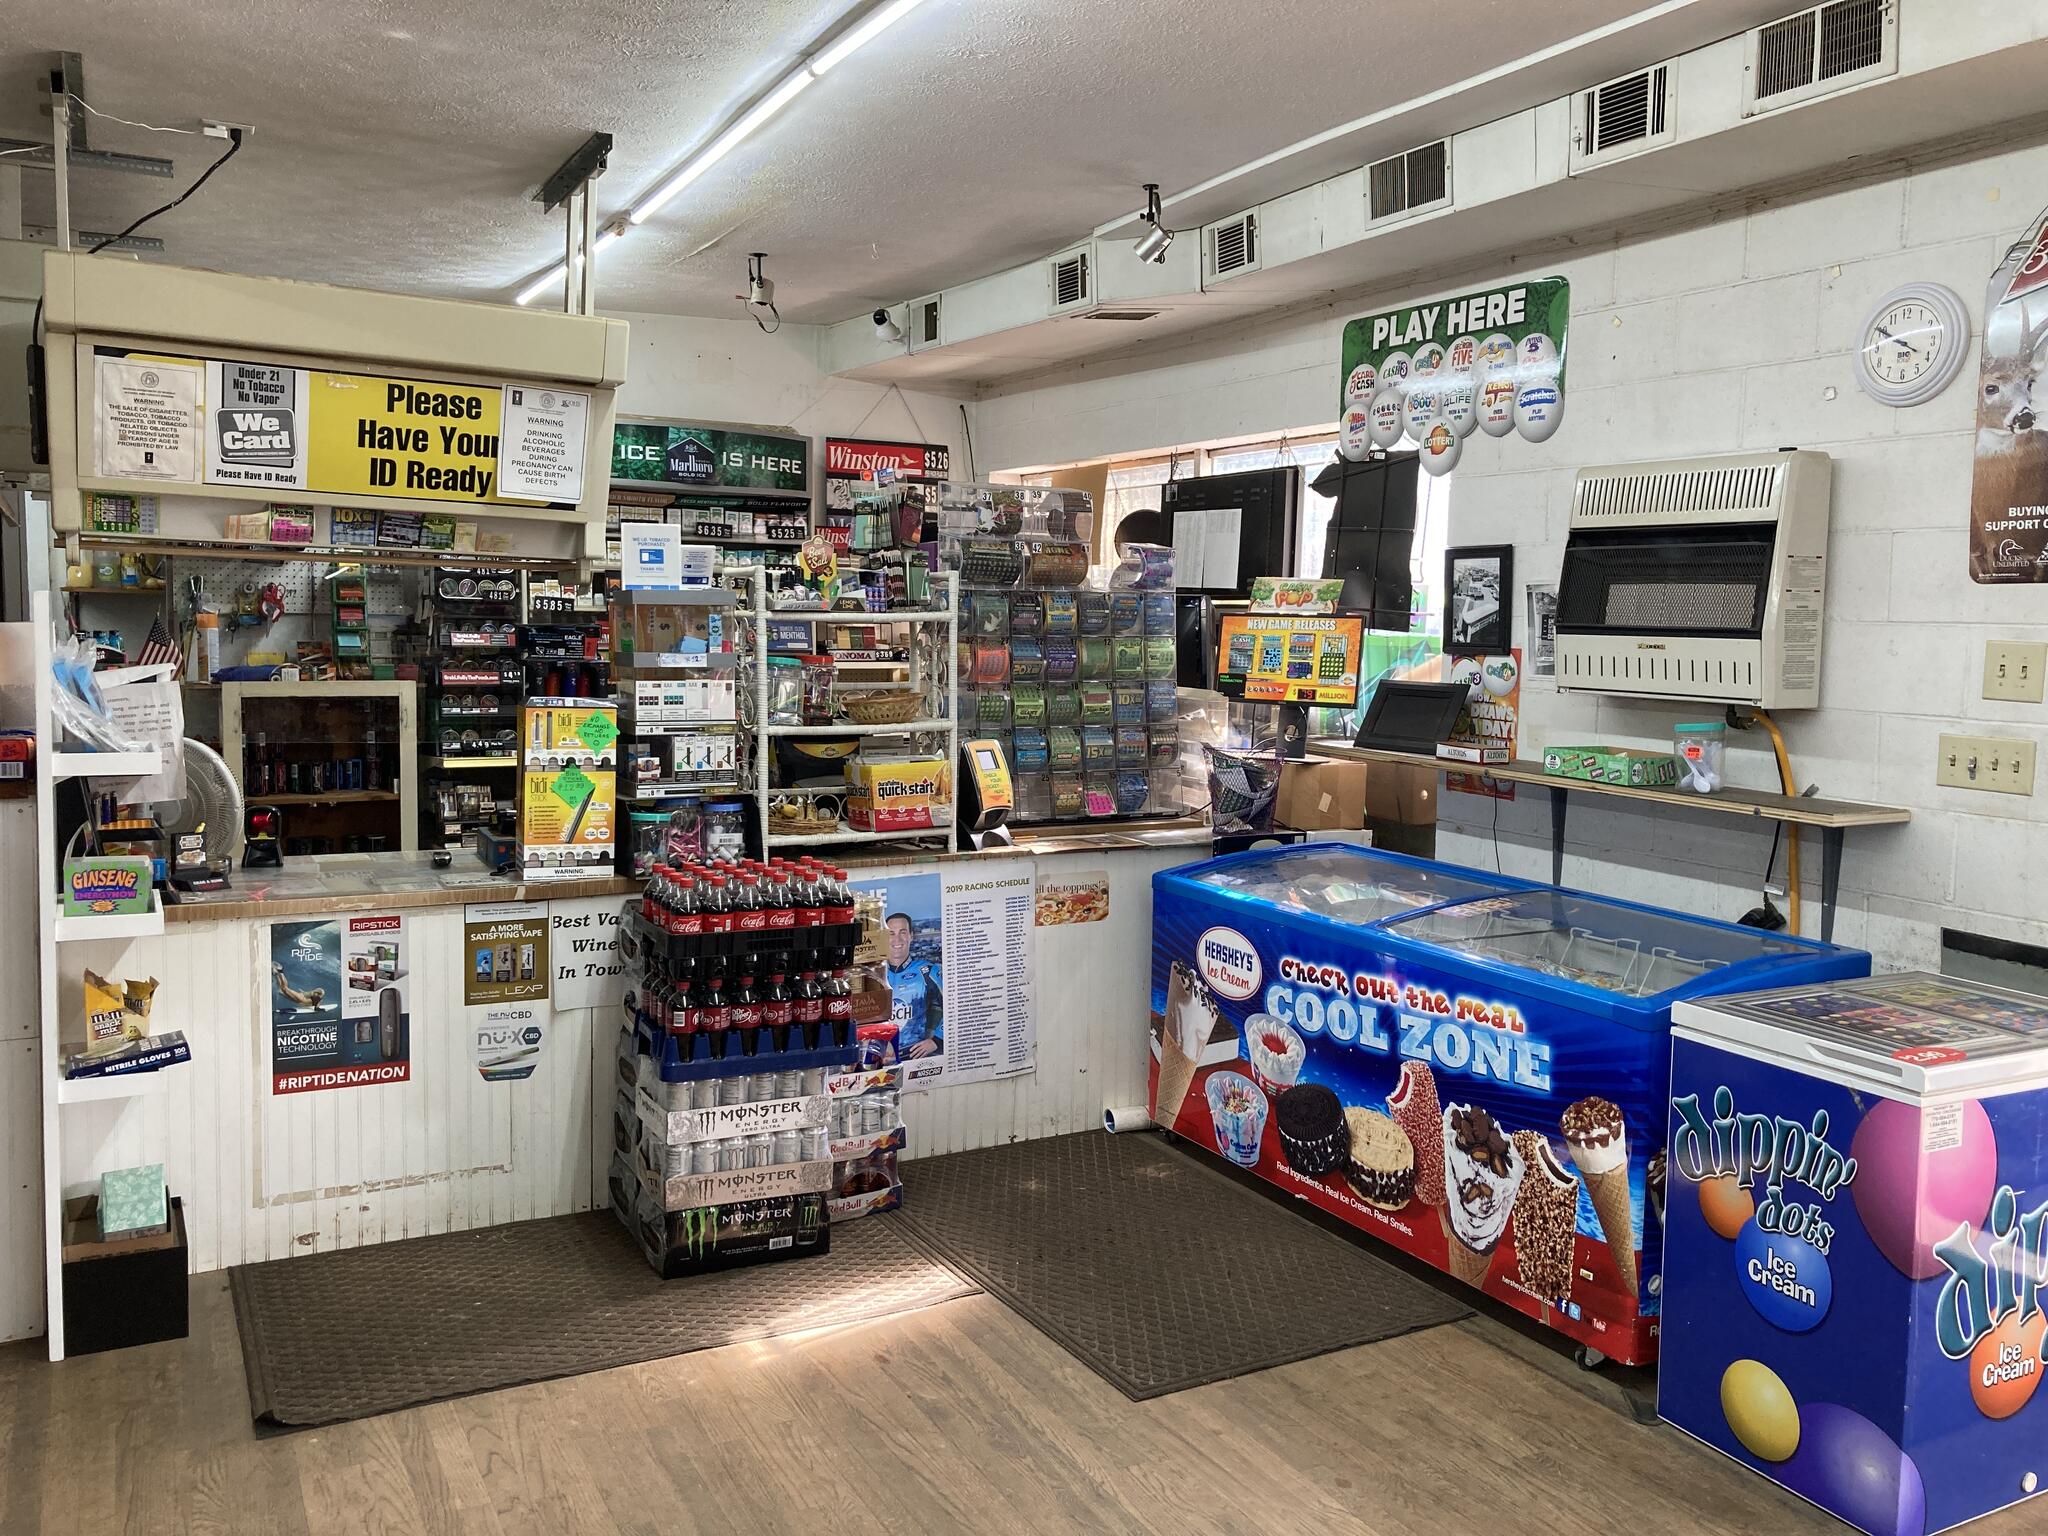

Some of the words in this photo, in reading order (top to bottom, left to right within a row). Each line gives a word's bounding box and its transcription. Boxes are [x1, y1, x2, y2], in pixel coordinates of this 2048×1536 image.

[1372, 306, 1440, 350] PLAY
[1447, 288, 1527, 336] HERE
[1889, 313, 1897, 326] 11
[1902, 307, 1912, 320] 12
[1930, 335, 1936, 347] 3
[1451, 350, 1473, 366] FIVE
[238, 367, 267, 381] Under
[269, 370, 280, 382] 21
[1357, 371, 1374, 380] CARD
[1887, 366, 1892, 378] 7
[1900, 368, 1905, 380] 6
[1914, 363, 1920, 375] 5
[233, 378, 246, 390] No
[248, 379, 285, 394] Tobacco
[1357, 378, 1375, 391] CASH
[133, 398, 165, 406] WARNING
[238, 390, 251, 402] No
[253, 392, 280, 406] Vapor
[386, 383, 482, 420] Please
[1444, 396, 1471, 407] 4LIFE
[151, 413, 181, 421] TOBACCO
[232, 413, 280, 432] We
[527, 416, 564, 428] WARNING
[223, 430, 291, 450] Card
[357, 419, 428, 452] Have
[440, 426, 499, 458] Your
[526, 430, 563, 440] DRINKING
[117, 441, 154, 449] PROHIBITED
[523, 437, 566, 448] ALCOHOLIC
[1424, 436, 1455, 448] LOTTERY
[521, 445, 566, 456] BEVERAGES
[528, 453, 558, 463] DURING
[620, 445, 661, 462] ICE
[722, 452, 744, 467] IS
[751, 455, 802, 475] HERE
[830, 446, 900, 470] Winston
[511, 460, 556, 471] PREGNANCY
[557, 465, 573, 473] CAN
[669, 458, 713, 475] Marlboro
[216, 468, 242, 480] Please
[244, 470, 262, 480] Have
[264, 471, 273, 482] ID
[275, 472, 297, 484] Ready
[369, 457, 396, 487] ID
[406, 460, 492, 498] Ready
[518, 468, 543, 478] CAUSE
[544, 471, 566, 480] BIRTH
[525, 477, 558, 487] DEFECTS
[1985, 519, 2041, 531] SUPPORT
[811, 556, 828, 569] Salt
[1992, 560, 2030, 568] UNLIMITED
[1248, 619, 1267, 629] NEW
[1268, 619, 1292, 630] GAME
[1295, 620, 1336, 631] RELEASES
[1318, 692, 1348, 700] MILLION
[1471, 702, 1515, 721] DRAWS
[530, 777, 547, 794] bidi
[878, 783, 907, 800] quick
[908, 781, 935, 794] start
[72, 869, 138, 889] GINSENG
[946, 885, 963, 893] 2019
[965, 883, 994, 892] RACING
[996, 878, 1030, 889] SCHEDULE
[1047, 885, 1060, 893] the
[353, 920, 399, 930] RIPSTICK
[553, 914, 594, 928] Best
[489, 925, 497, 933] A
[498, 923, 524, 933] MORE
[470, 930, 519, 941] SATISFYING
[521, 929, 543, 938] VAPE
[573, 939, 617, 952] Wine
[299, 953, 323, 961] TIDE
[1205, 940, 1253, 972] HERSHEY'S
[558, 967, 577, 980] In
[1207, 961, 1219, 978] Ice
[1220, 966, 1250, 991] Cream
[505, 984, 544, 996] LEAP
[1355, 976, 1399, 1003] out
[1407, 987, 1450, 1015] the
[1456, 996, 1524, 1034] real
[511, 1011, 532, 1019] CBD
[888, 1007, 912, 1021] SCH
[95, 1020, 121, 1031] snack
[100, 1027, 118, 1035] mix
[277, 1025, 338, 1037] BREAKTHROUGH
[277, 1031, 338, 1048] NICOTINE
[1266, 986, 1389, 1052] COOL
[1400, 1015, 1551, 1093] ZONE
[278, 1042, 338, 1053] TECHNOLOGY
[105, 1060, 137, 1073] NITRILE
[138, 1051, 171, 1064] GLOVES
[174, 1047, 186, 1055] 100
[278, 1066, 406, 1090] #RIPTIDENATION
[917, 1067, 942, 1077] NASCAR
[721, 1101, 802, 1121] MONSTER
[735, 1117, 787, 1129] ENERGY
[1672, 1086, 1857, 1203] dippin'
[717, 1169, 797, 1188] MONSTER
[732, 1184, 781, 1195] ENERGY
[744, 1191, 767, 1199] ULTRA
[1276, 1161, 1289, 1172] Real
[1290, 1167, 1324, 1191] Ingredients.
[1325, 1185, 1339, 1199] Real
[1340, 1191, 1349, 1204] Ice
[1350, 1198, 1373, 1217] Cream.
[1374, 1209, 1389, 1224] Real
[1390, 1217, 1414, 1237] Smiles.
[722, 1208, 792, 1225] MONSTER
[1756, 1187, 1835, 1256] dots
[1767, 1247, 1797, 1278] Ice
[1747, 1259, 1815, 1308] Cream
[1501, 1275, 1555, 1308] hersheyicecream.com
[1998, 1342, 2021, 1366] Ice
[1982, 1355, 2035, 1389] Cream
